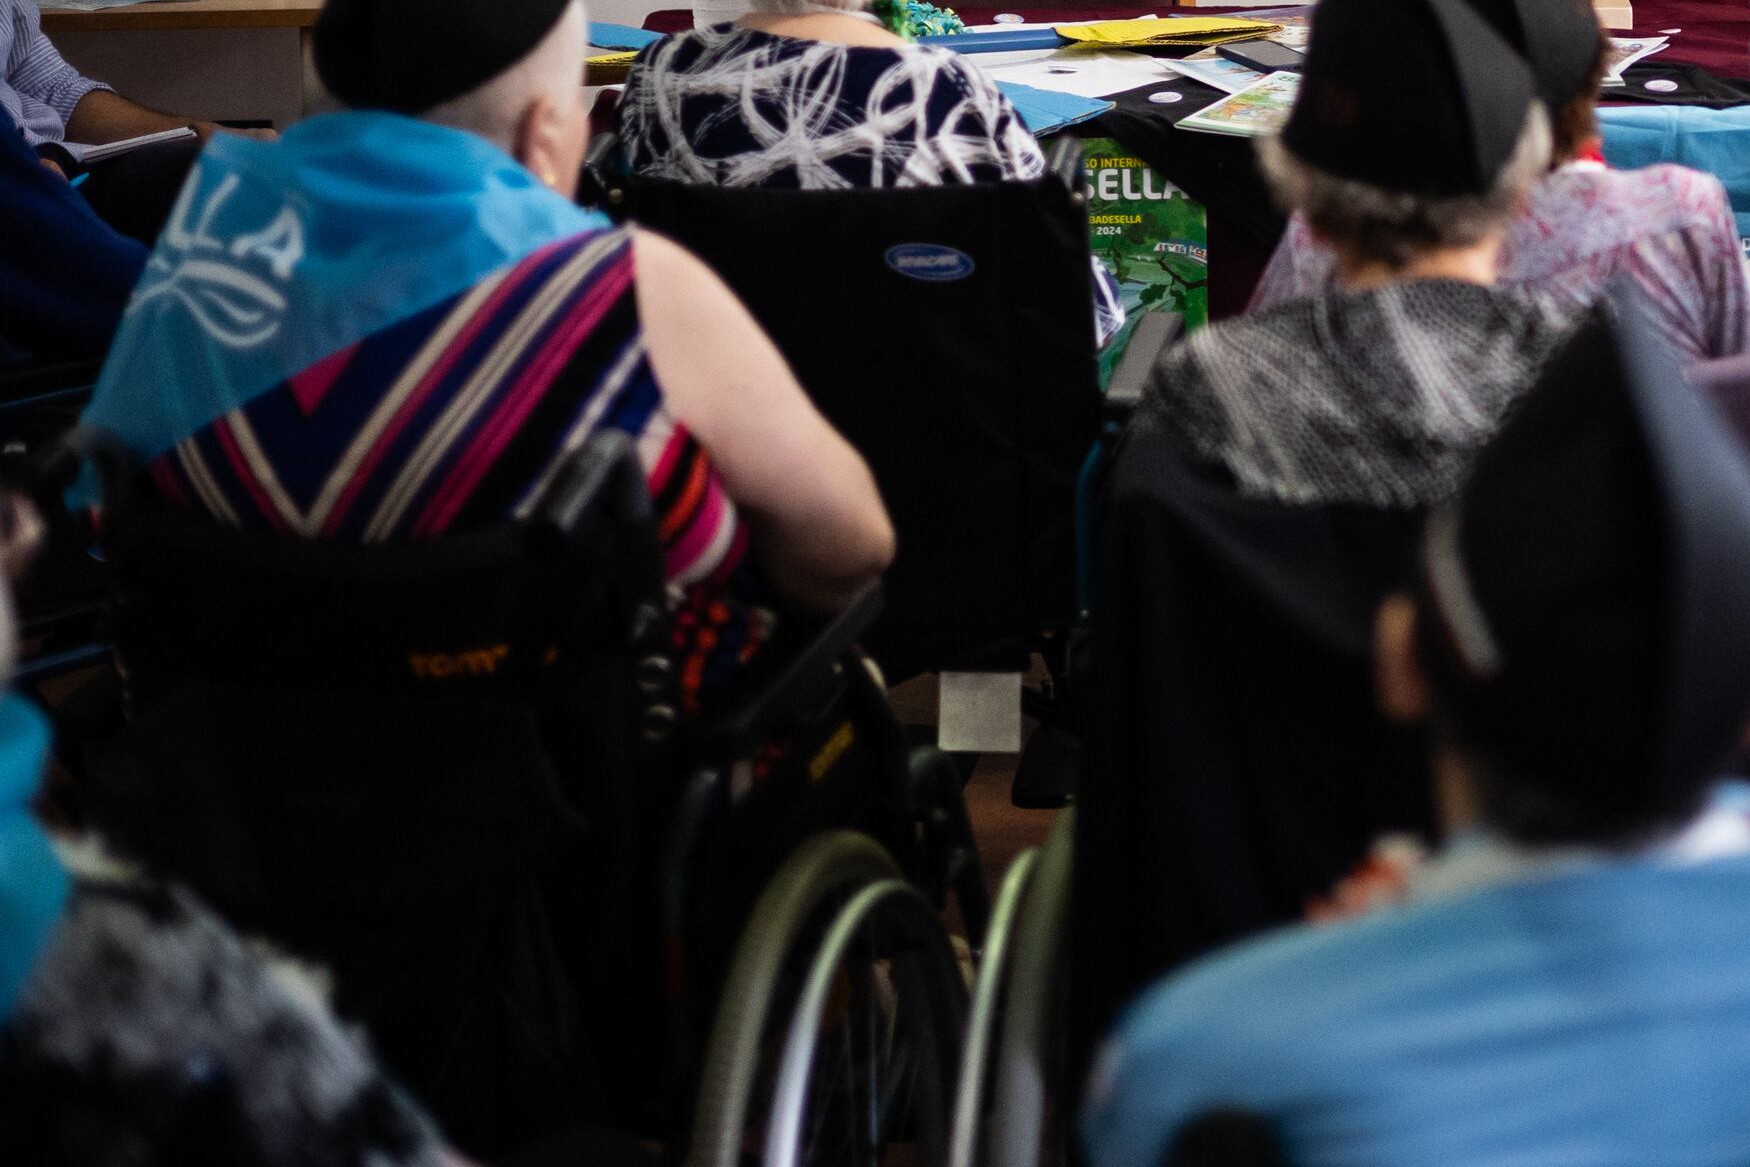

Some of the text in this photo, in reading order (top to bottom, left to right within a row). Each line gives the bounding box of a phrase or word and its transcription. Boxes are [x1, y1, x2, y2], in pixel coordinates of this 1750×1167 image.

[1101, 158, 1145, 168] INTERN
[1089, 215, 1142, 224] BADESELLA
[1097, 227, 1121, 235] 2024
